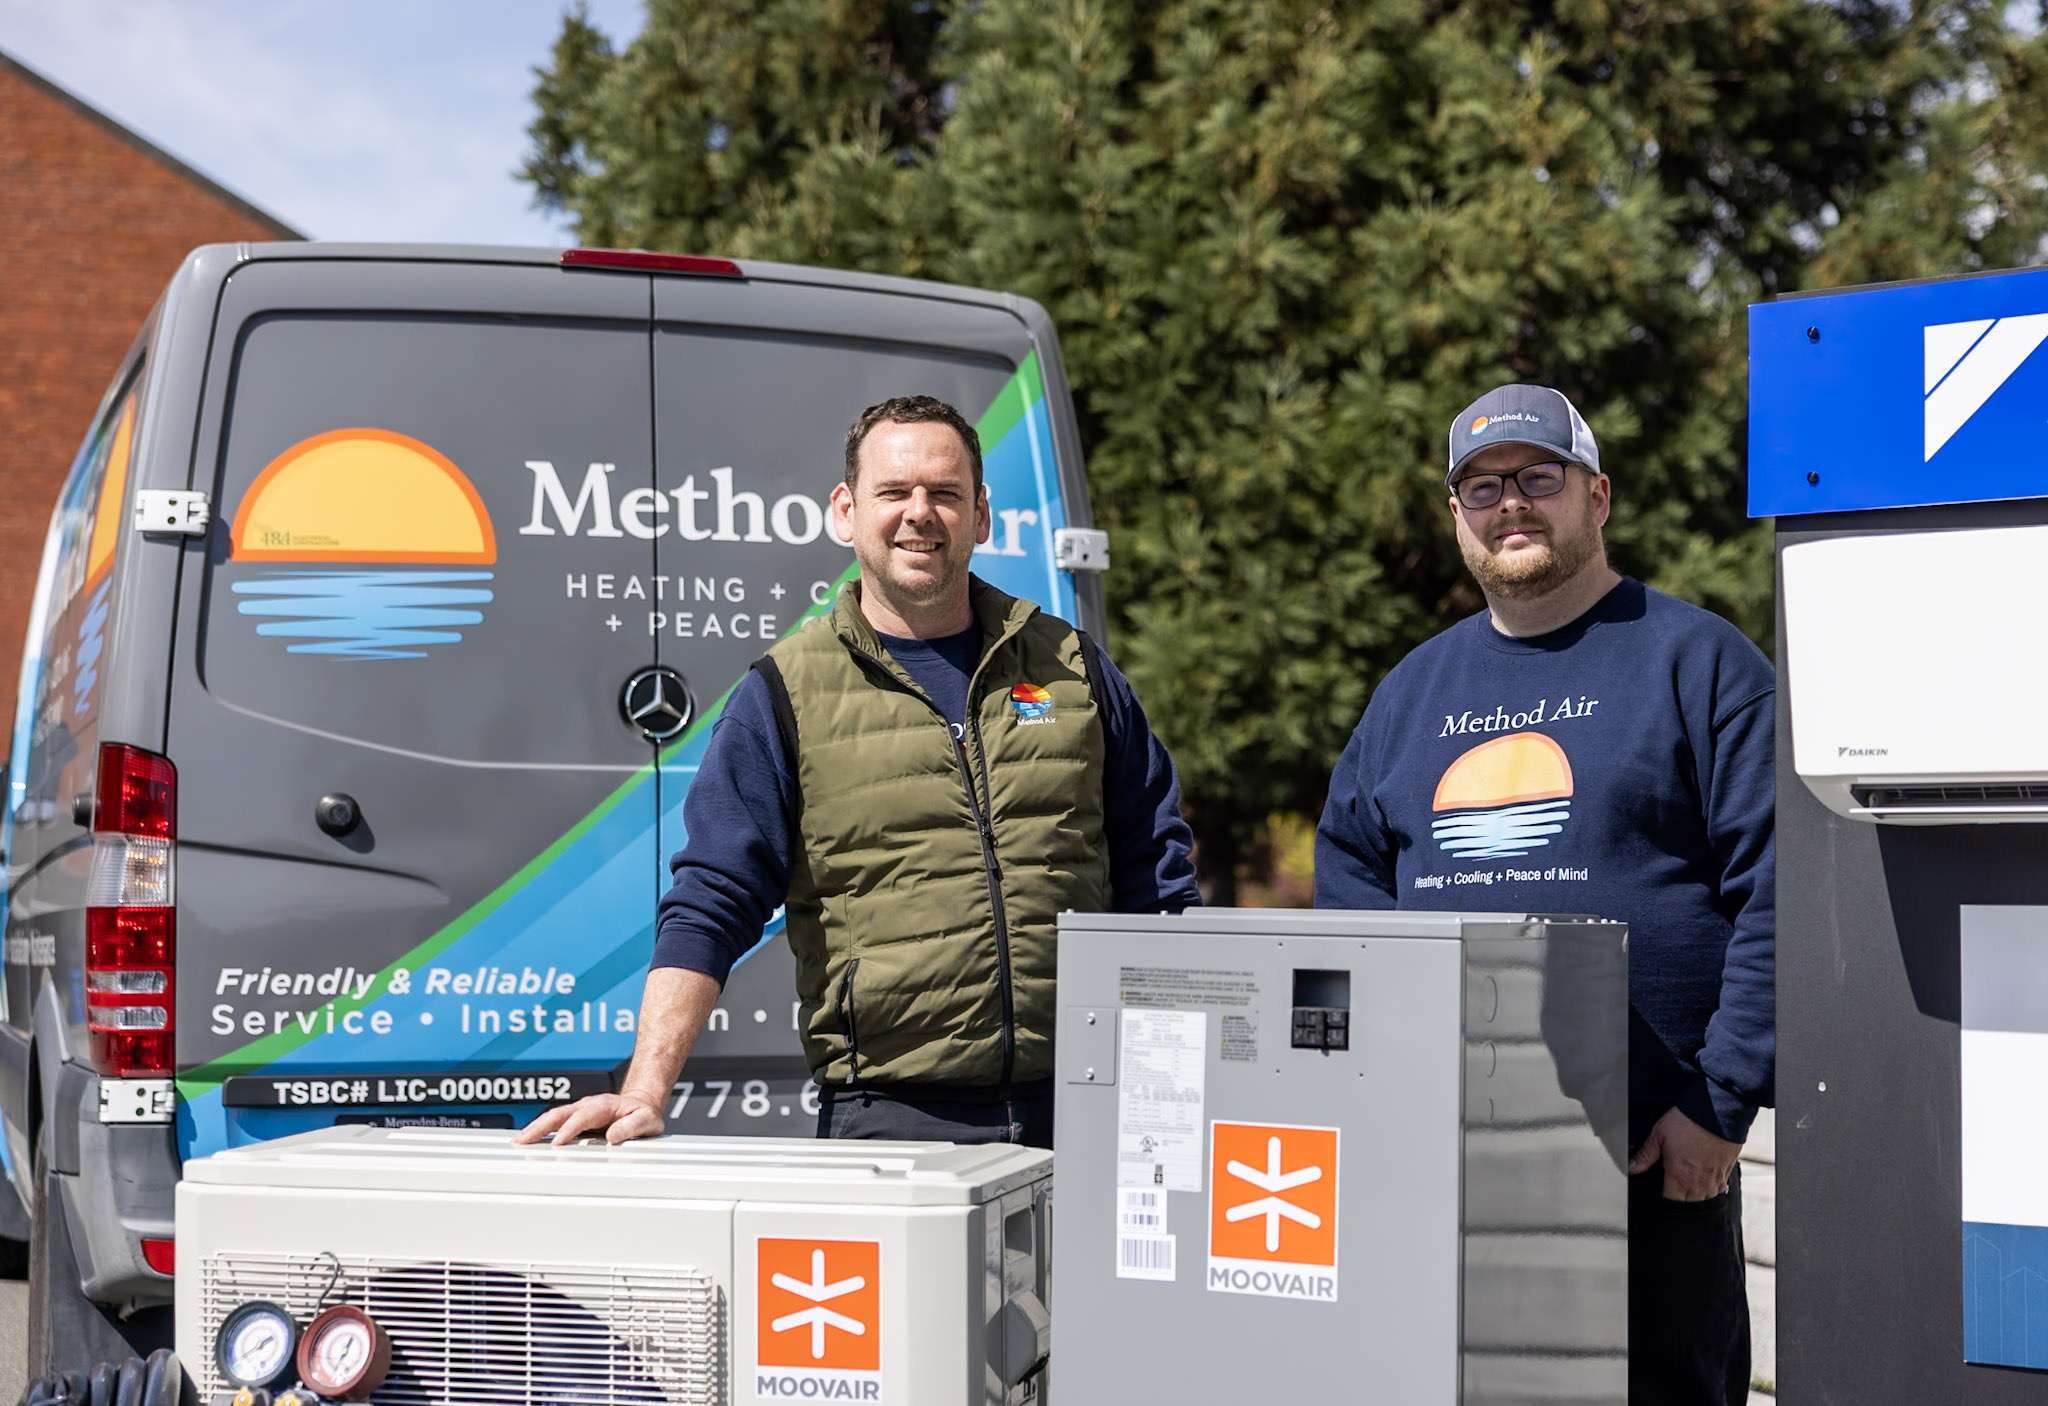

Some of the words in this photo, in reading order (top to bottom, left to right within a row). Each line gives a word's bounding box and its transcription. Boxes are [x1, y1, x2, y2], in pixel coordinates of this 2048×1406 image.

[1489, 412, 1523, 425] Method
[1525, 413, 1539, 423] Air
[566, 574, 745, 602] HEATING
[649, 612, 777, 640] PEACE
[1017, 717, 1045, 727] Method
[1045, 716, 1056, 724] Air
[1438, 699, 1546, 738] Method
[1550, 695, 1600, 722] Air
[1848, 748, 1889, 756] DAIKIN
[1414, 875, 1444, 889] Heating
[1454, 870, 1494, 885] Cooling
[1506, 868, 1541, 881] Peace
[1544, 868, 1556, 881] of
[1559, 868, 1588, 881] Mind
[215, 967, 376, 1000] Friendly
[387, 968, 412, 995] &
[425, 967, 576, 995] Reliable
[211, 1004, 393, 1036] Service
[461, 1002, 729, 1034] Installan
[273, 1080, 369, 1105] TSBC#
[378, 1077, 571, 1101] LIC-00001152
[669, 1079, 823, 1120] 778.6
[384, 1117, 467, 1129] Mercedes-Benz
[1209, 1267, 1334, 1298] MOOVAIR
[757, 1376, 880, 1400] MOOVAIR
